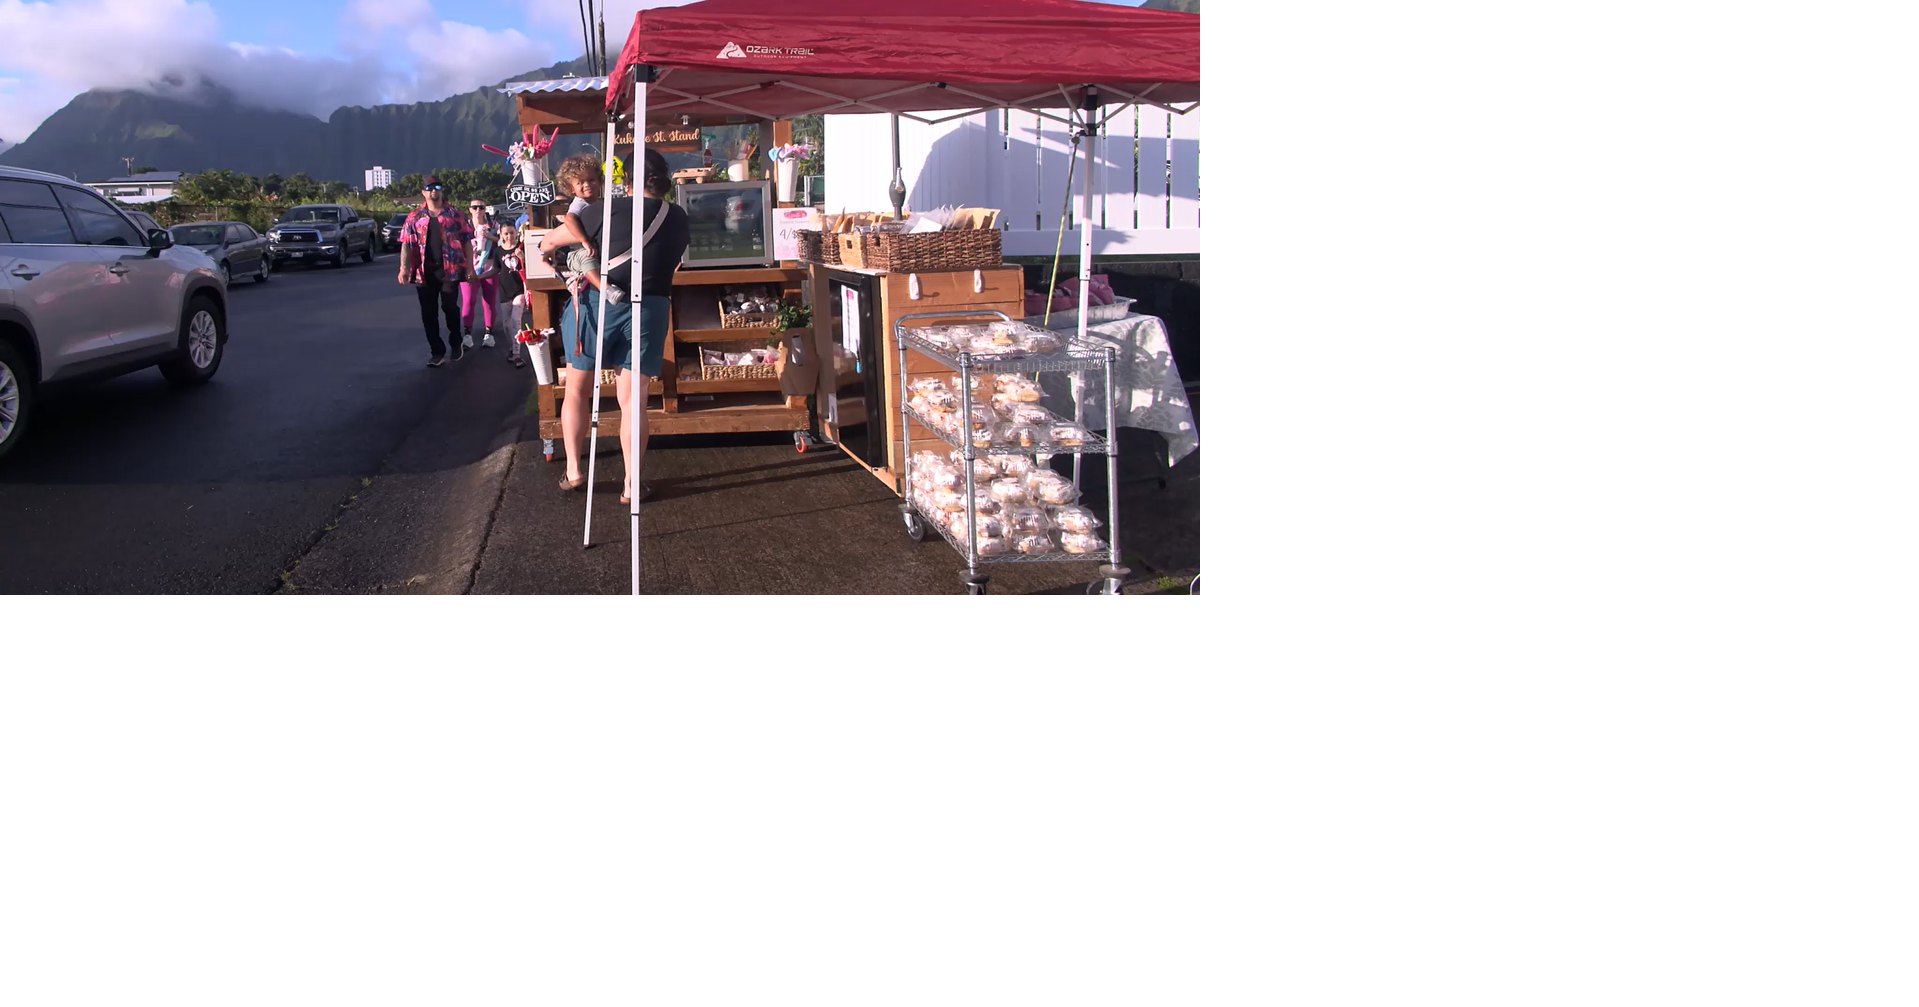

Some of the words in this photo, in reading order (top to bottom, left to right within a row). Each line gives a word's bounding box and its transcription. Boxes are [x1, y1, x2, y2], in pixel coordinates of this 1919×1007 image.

[613, 132, 651, 145] Kuke
[652, 130, 667, 142] St.
[669, 128, 700, 142] Stand
[510, 190, 551, 203] OPEN
